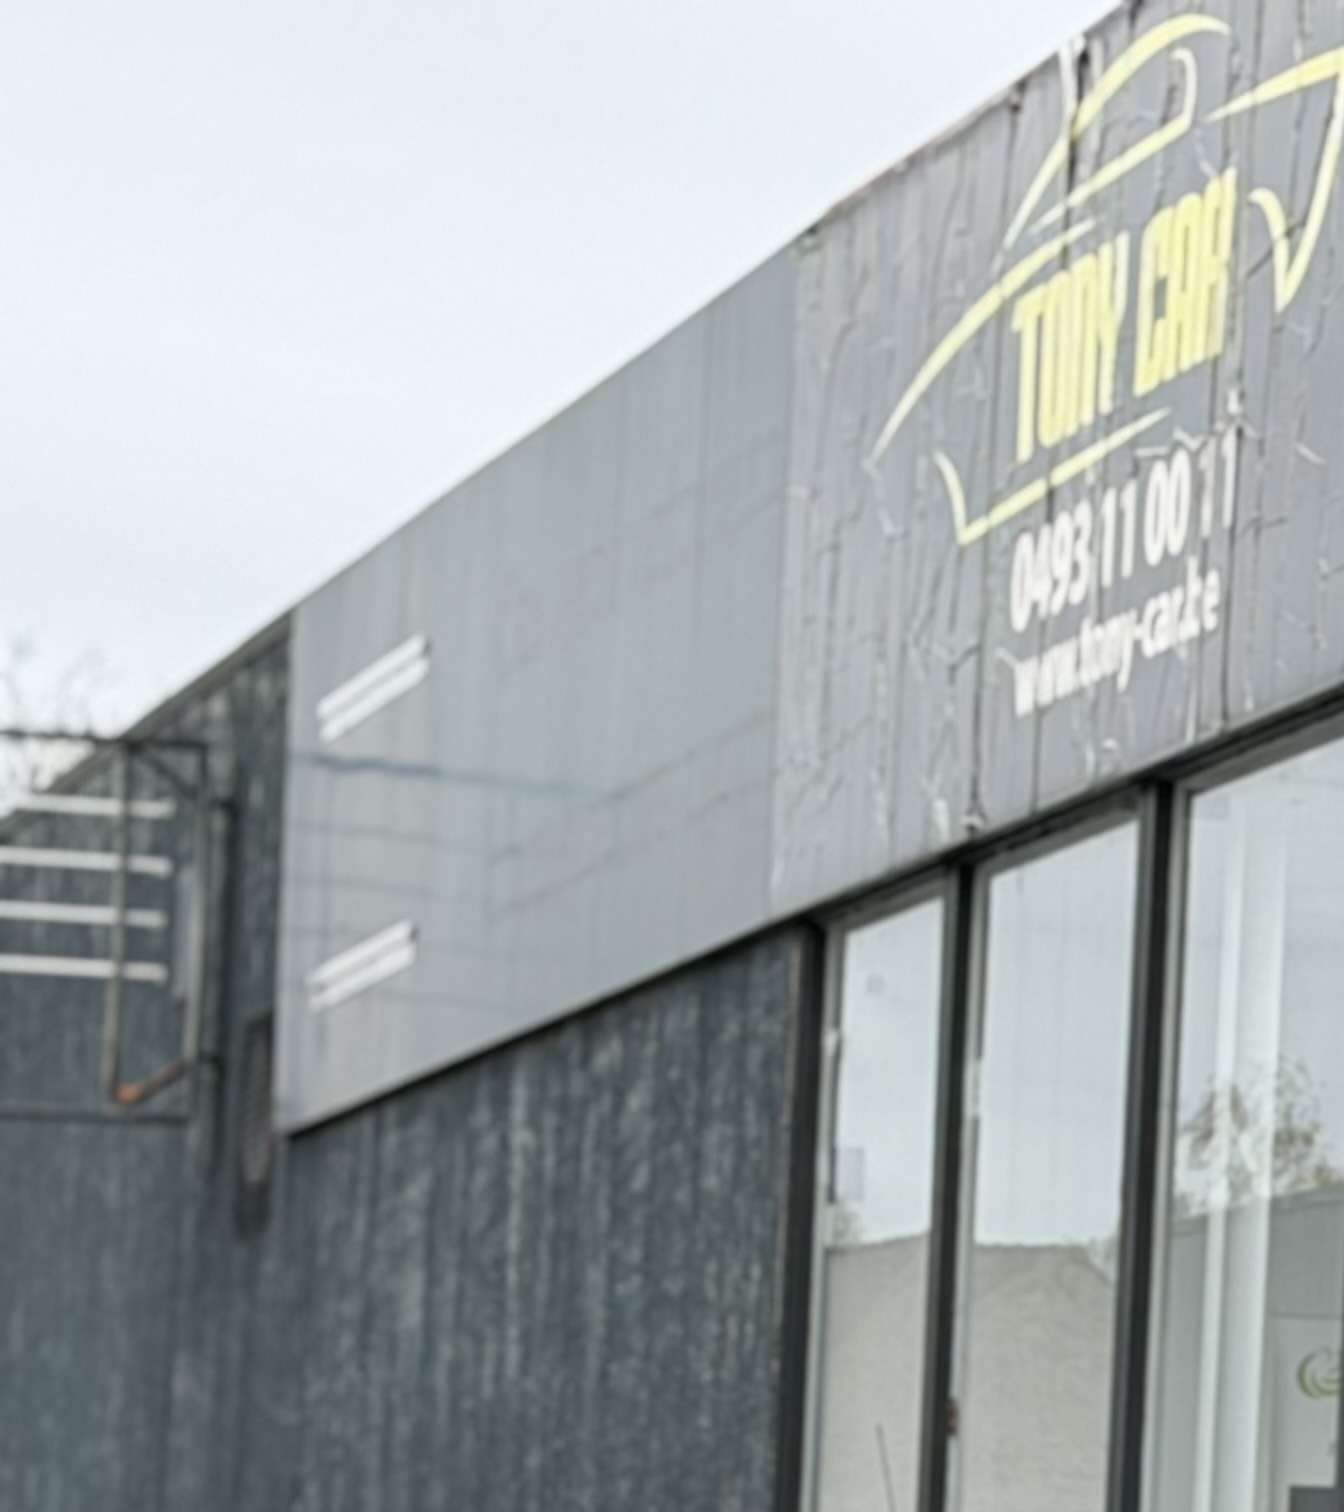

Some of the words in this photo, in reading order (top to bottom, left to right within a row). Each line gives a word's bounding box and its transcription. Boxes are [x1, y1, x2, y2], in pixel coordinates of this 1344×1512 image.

[1012, 229, 1129, 464] TONY
[1133, 165, 1237, 397] CAR
[1010, 499, 1092, 634] 0493
[1102, 479, 1137, 588] 11
[1144, 449, 1191, 566] 00
[1199, 427, 1236, 537] 11
